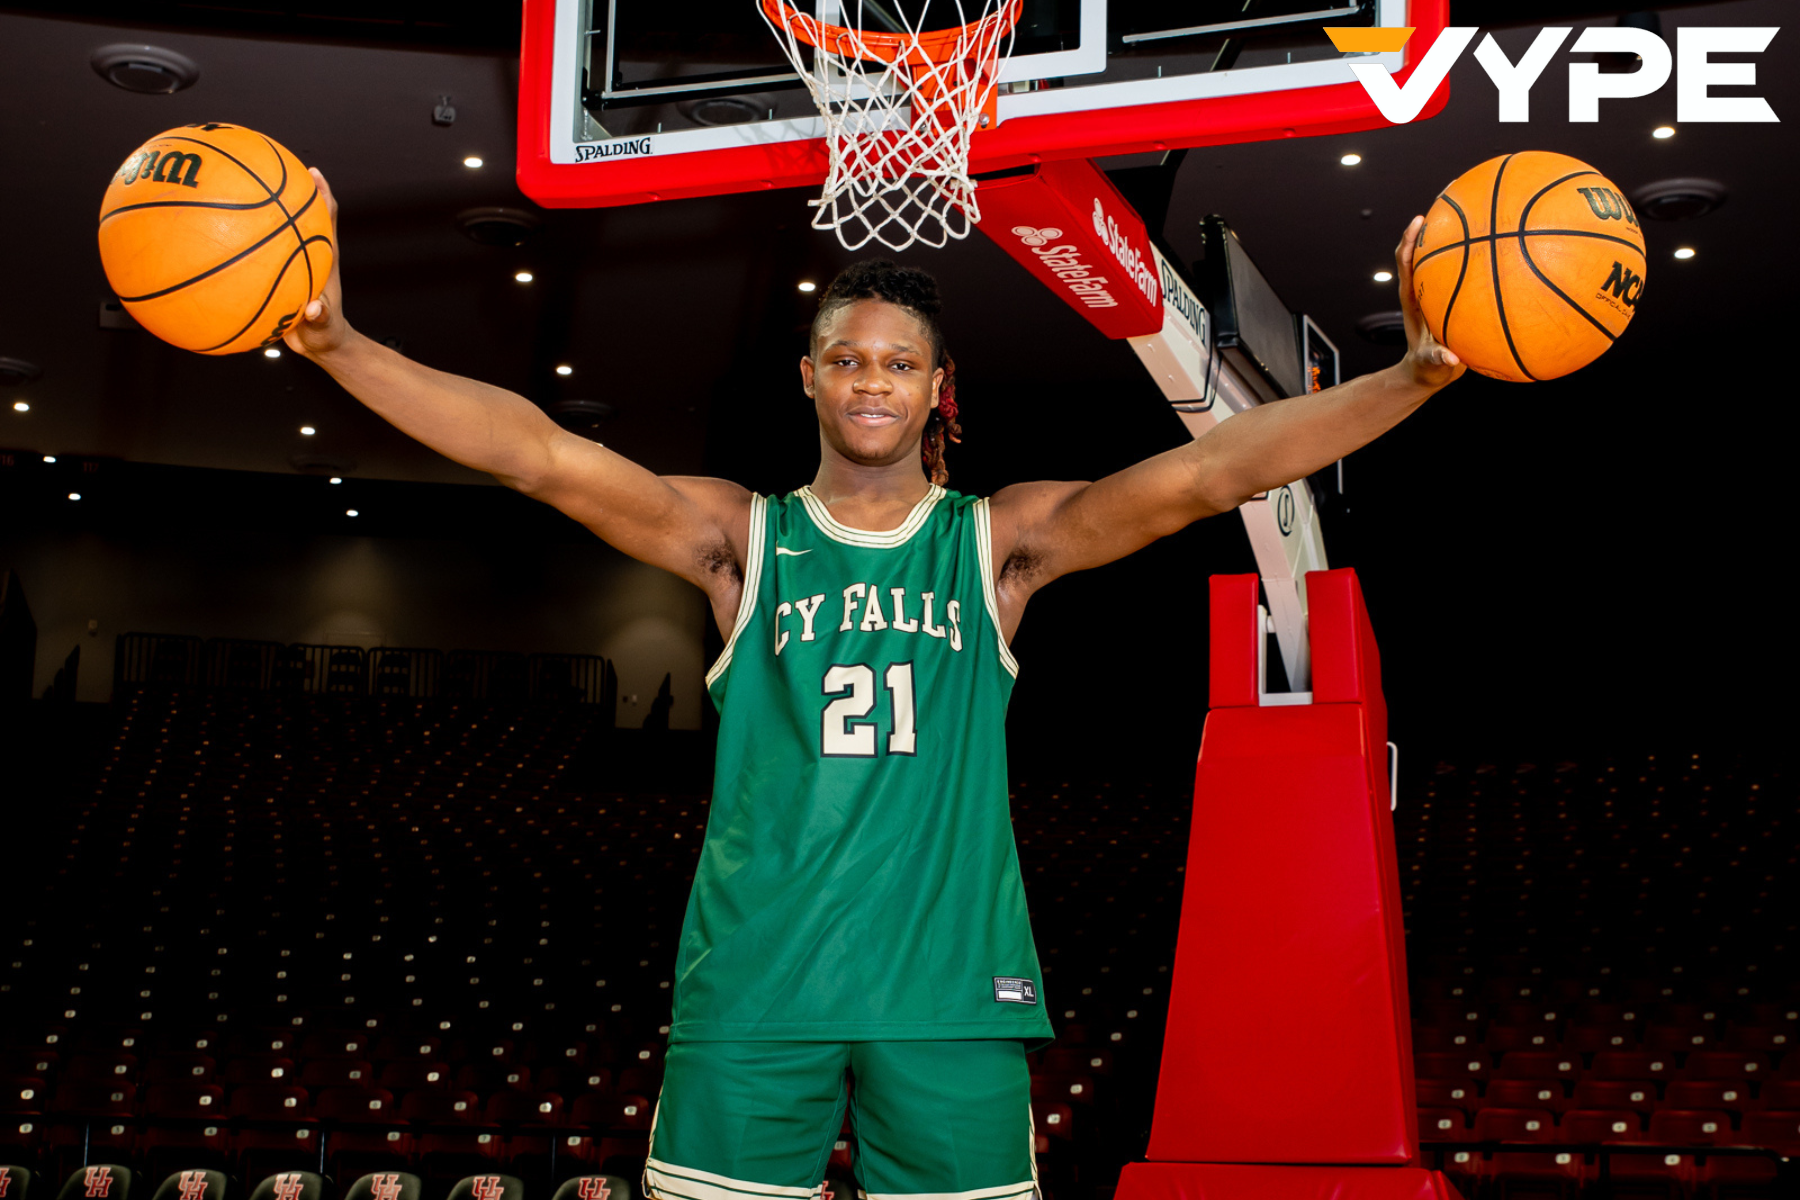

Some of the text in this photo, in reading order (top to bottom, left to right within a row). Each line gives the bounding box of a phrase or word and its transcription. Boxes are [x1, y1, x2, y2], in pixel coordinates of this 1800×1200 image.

[575, 137, 651, 163] SPALDING
[1161, 259, 1207, 347] SPALDING
[775, 582, 963, 657] CY FALLS
[820, 659, 918, 759] 21
[1024, 985, 1035, 997] XL
